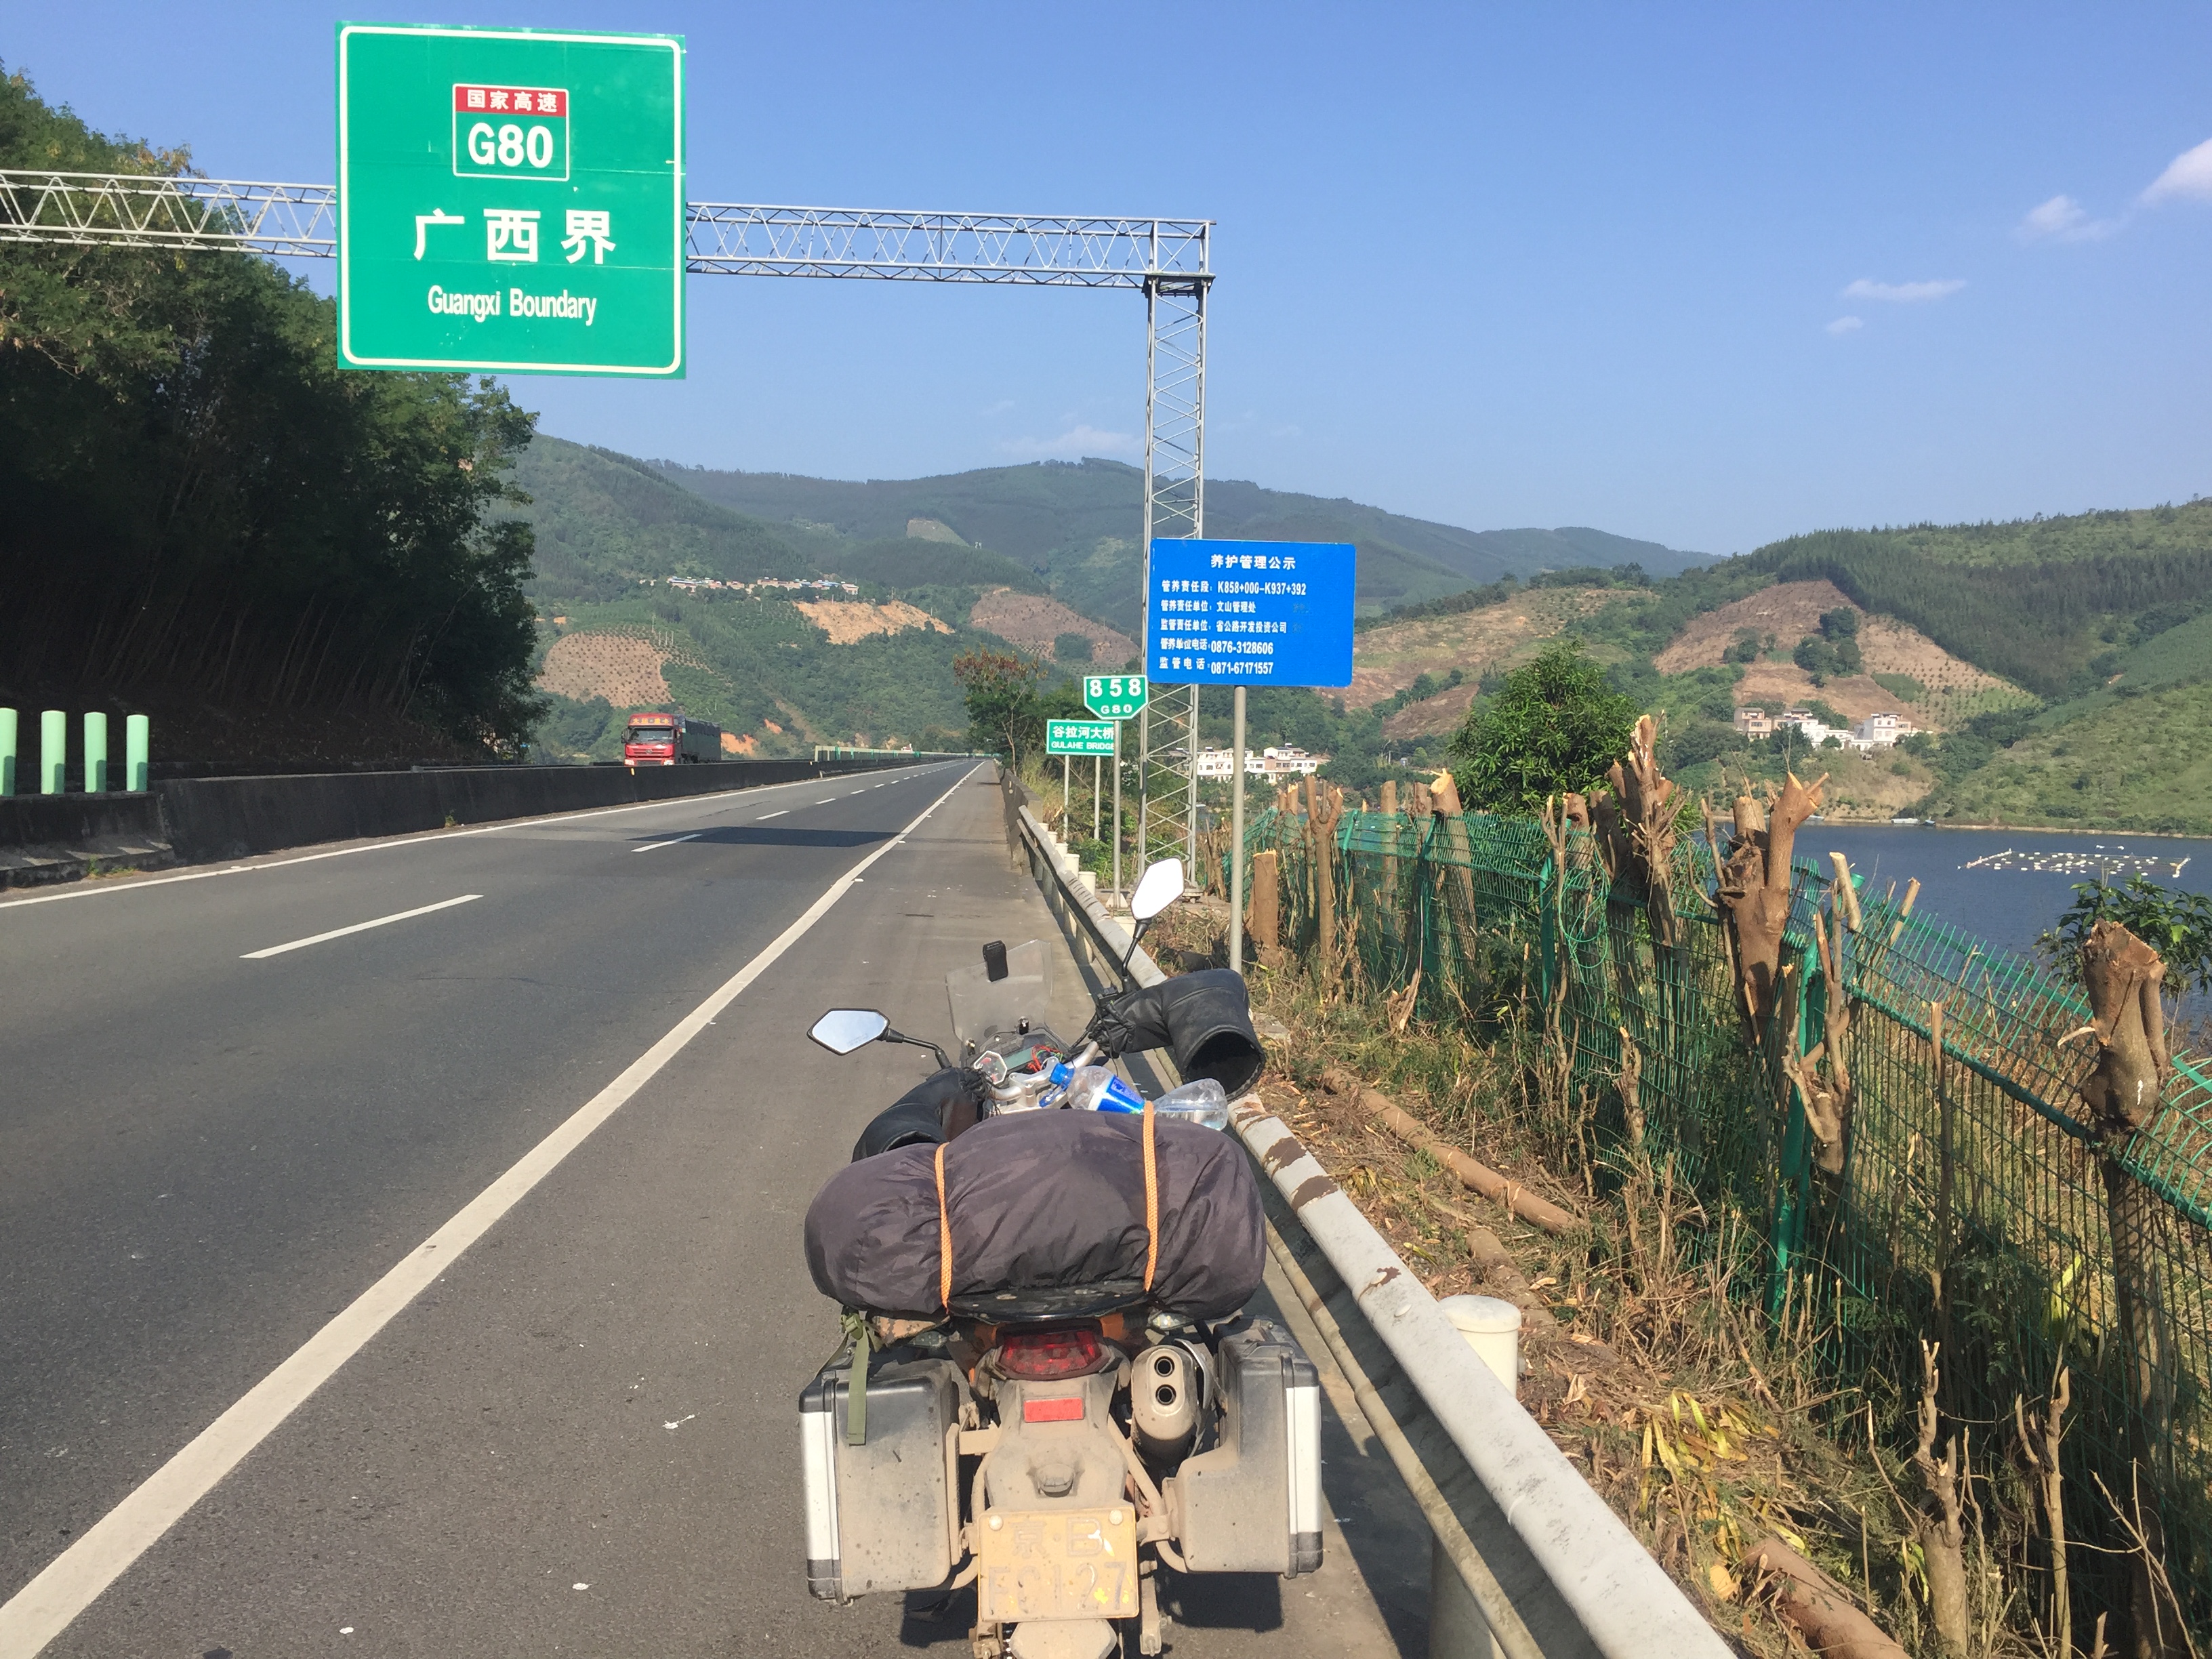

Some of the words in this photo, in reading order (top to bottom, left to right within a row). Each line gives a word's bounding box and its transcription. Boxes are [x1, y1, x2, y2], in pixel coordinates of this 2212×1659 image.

[467, 89, 558, 113] 国家高速
[468, 122, 554, 169] G80
[413, 207, 616, 265] 广西界
[428, 285, 501, 323] Guangxi
[510, 287, 597, 326] Boundary
[1210, 554, 1296, 571] 养护管理公示
[1089, 678, 1142, 697] 858
[1101, 704, 1132, 714] G80
[1052, 725, 1114, 740] 谷拉河大桥
[1051, 741, 1084, 750] GULAHE
